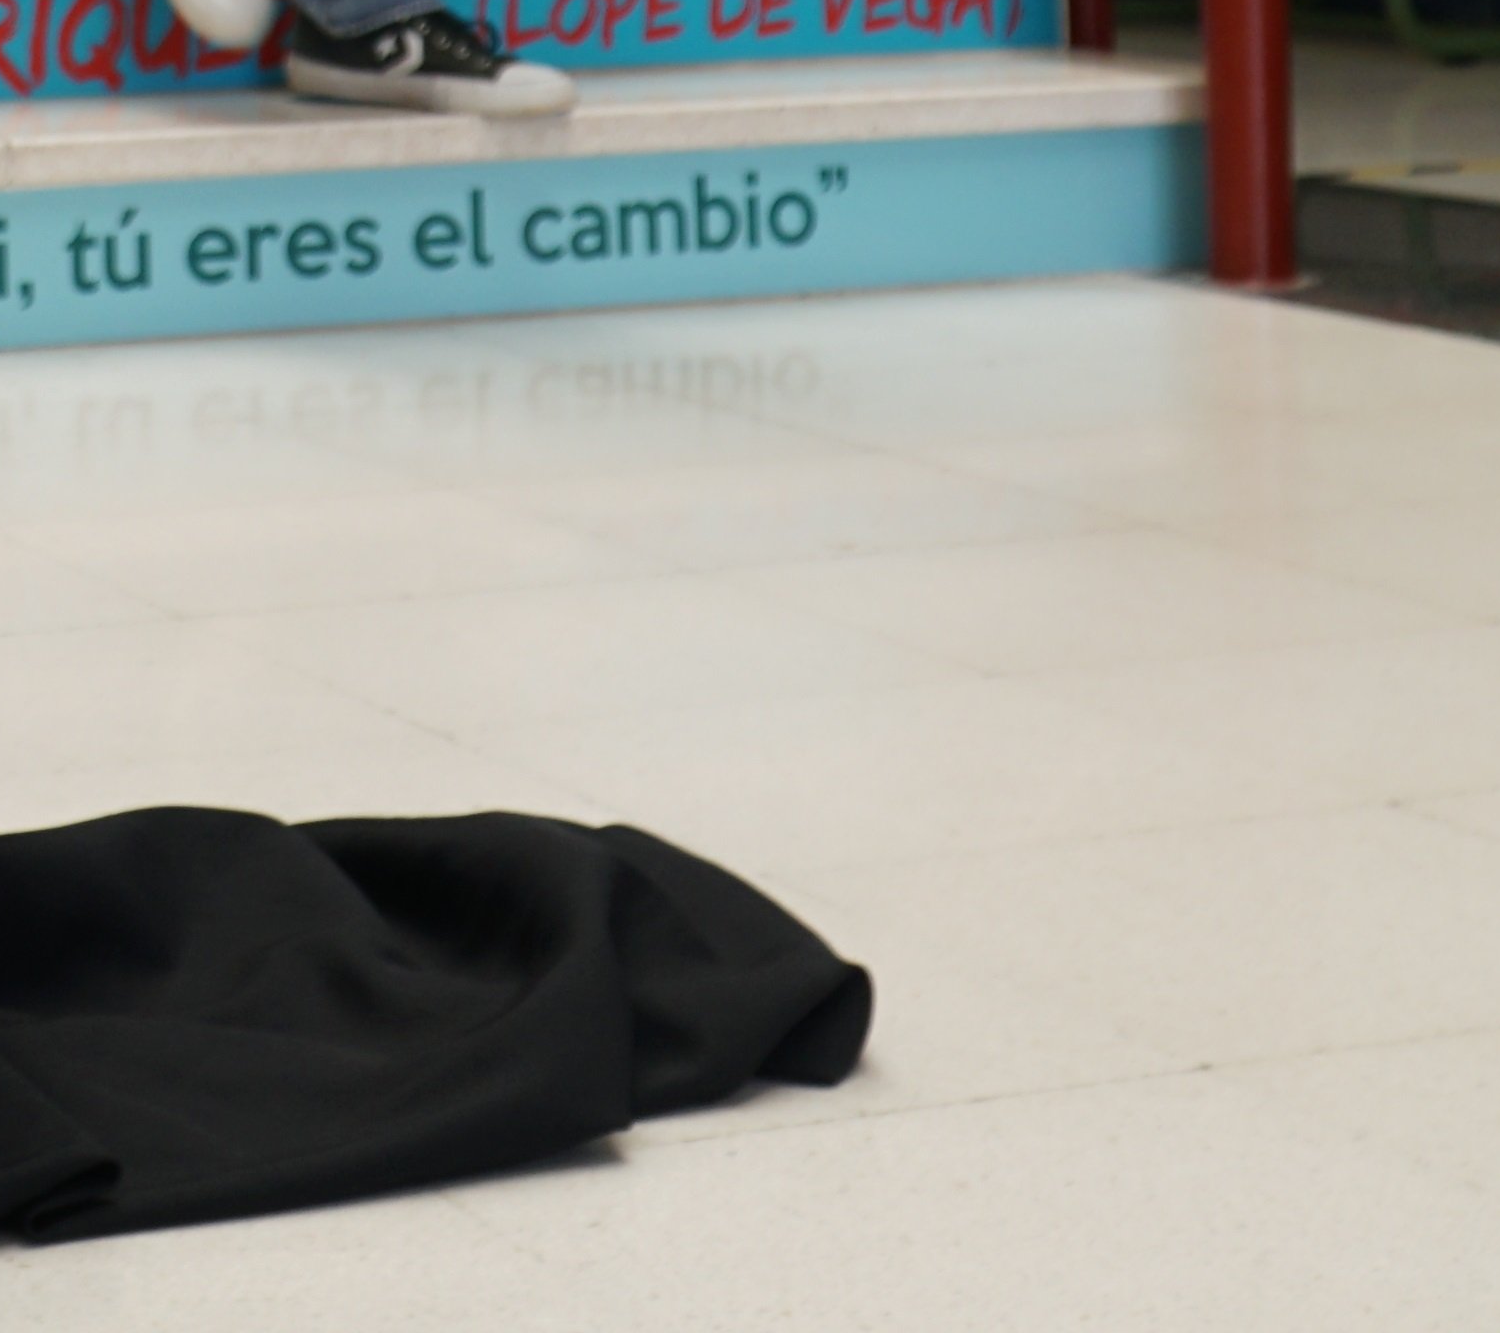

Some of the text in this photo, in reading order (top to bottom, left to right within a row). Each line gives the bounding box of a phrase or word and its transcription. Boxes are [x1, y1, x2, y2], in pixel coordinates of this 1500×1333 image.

[66, 208, 152, 294] tú
[186, 215, 382, 286] eres
[413, 188, 494, 270] el
